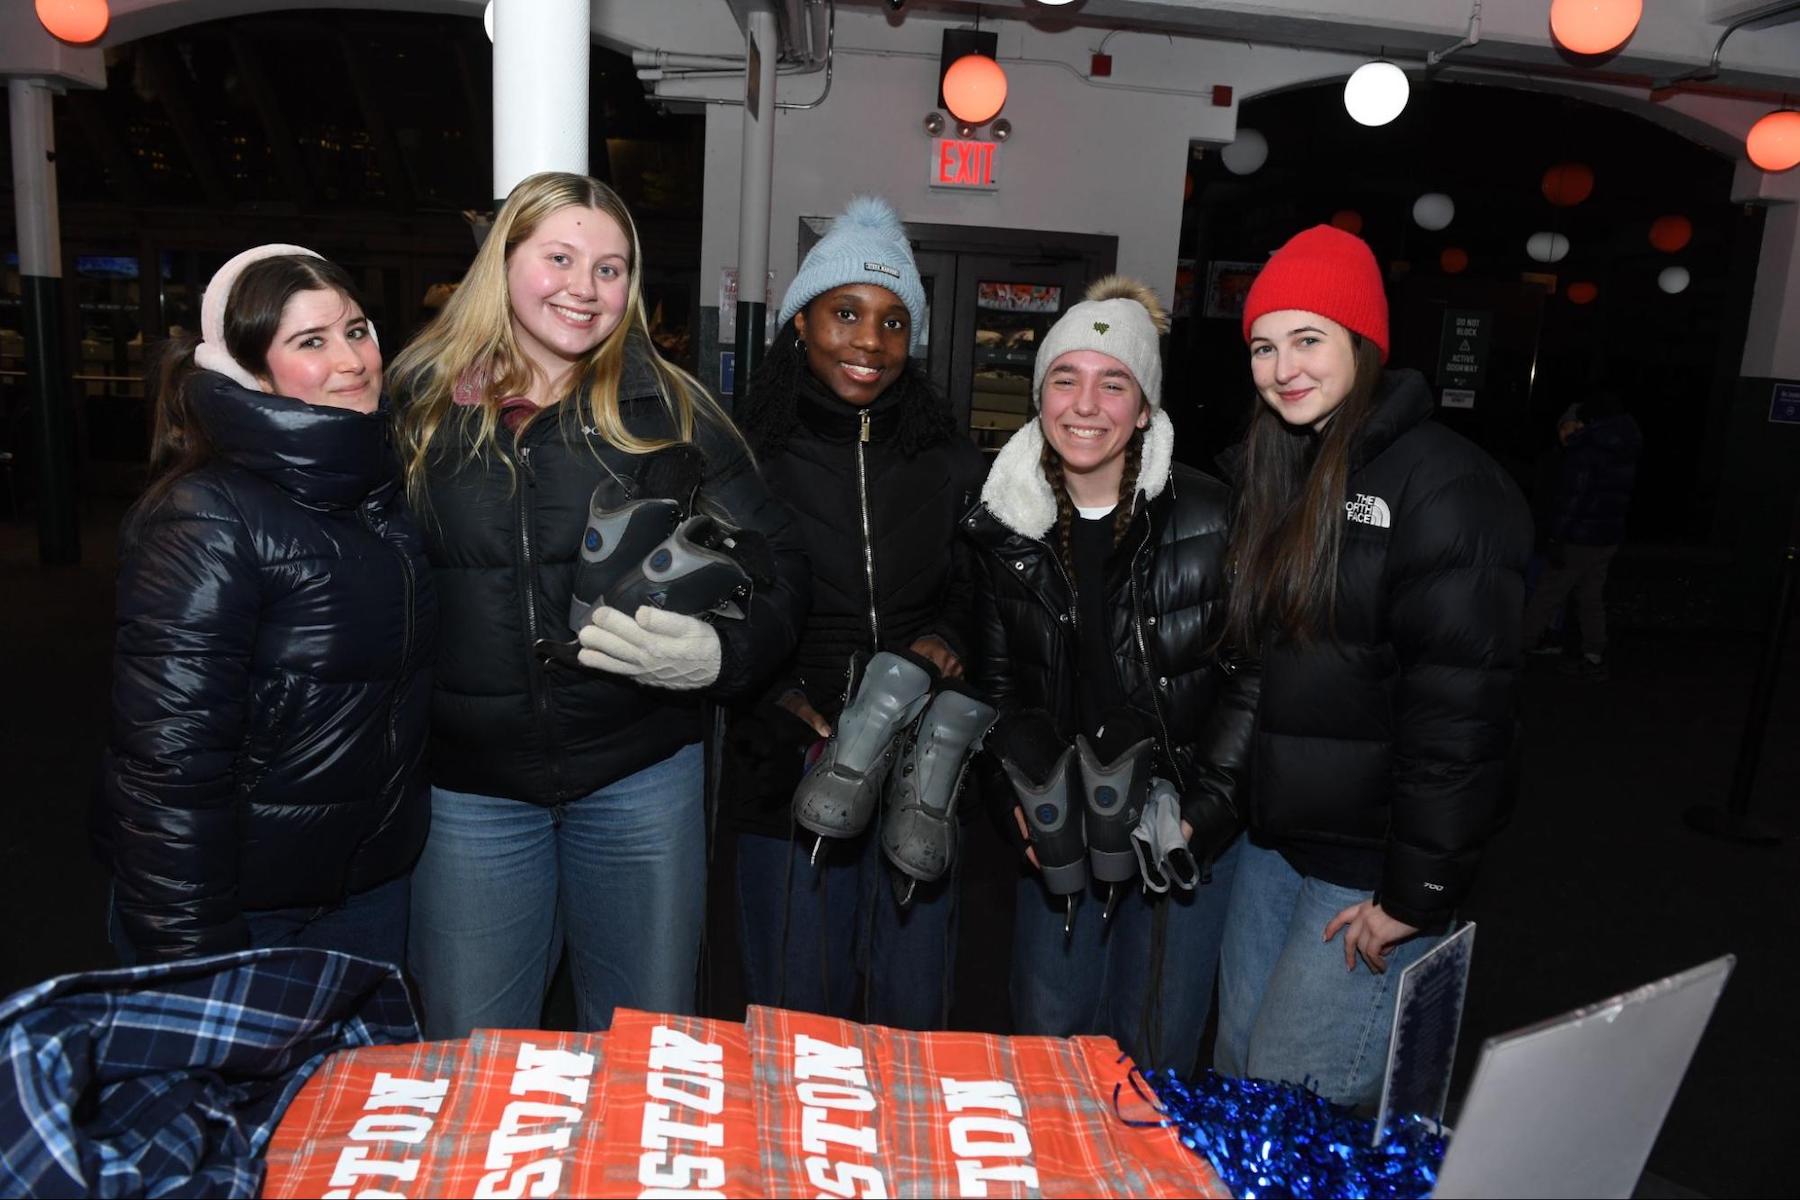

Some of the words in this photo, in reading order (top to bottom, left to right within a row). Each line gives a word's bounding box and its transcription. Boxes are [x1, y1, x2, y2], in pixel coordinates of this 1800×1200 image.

[939, 139, 997, 186] EXIT
[1456, 318, 1466, 326] DO
[1467, 319, 1480, 327] NOT
[1456, 327, 1477, 336] BLOCK
[1452, 354, 1475, 363] ACTIVE
[1446, 363, 1479, 373] DOORWAY
[1356, 493, 1376, 506] THE
[1344, 501, 1374, 516] ORTH
[1347, 511, 1371, 525] FACE
[637, 1025, 726, 1199] STON
[794, 1033, 888, 1199] STON
[321, 1072, 450, 1199] TON
